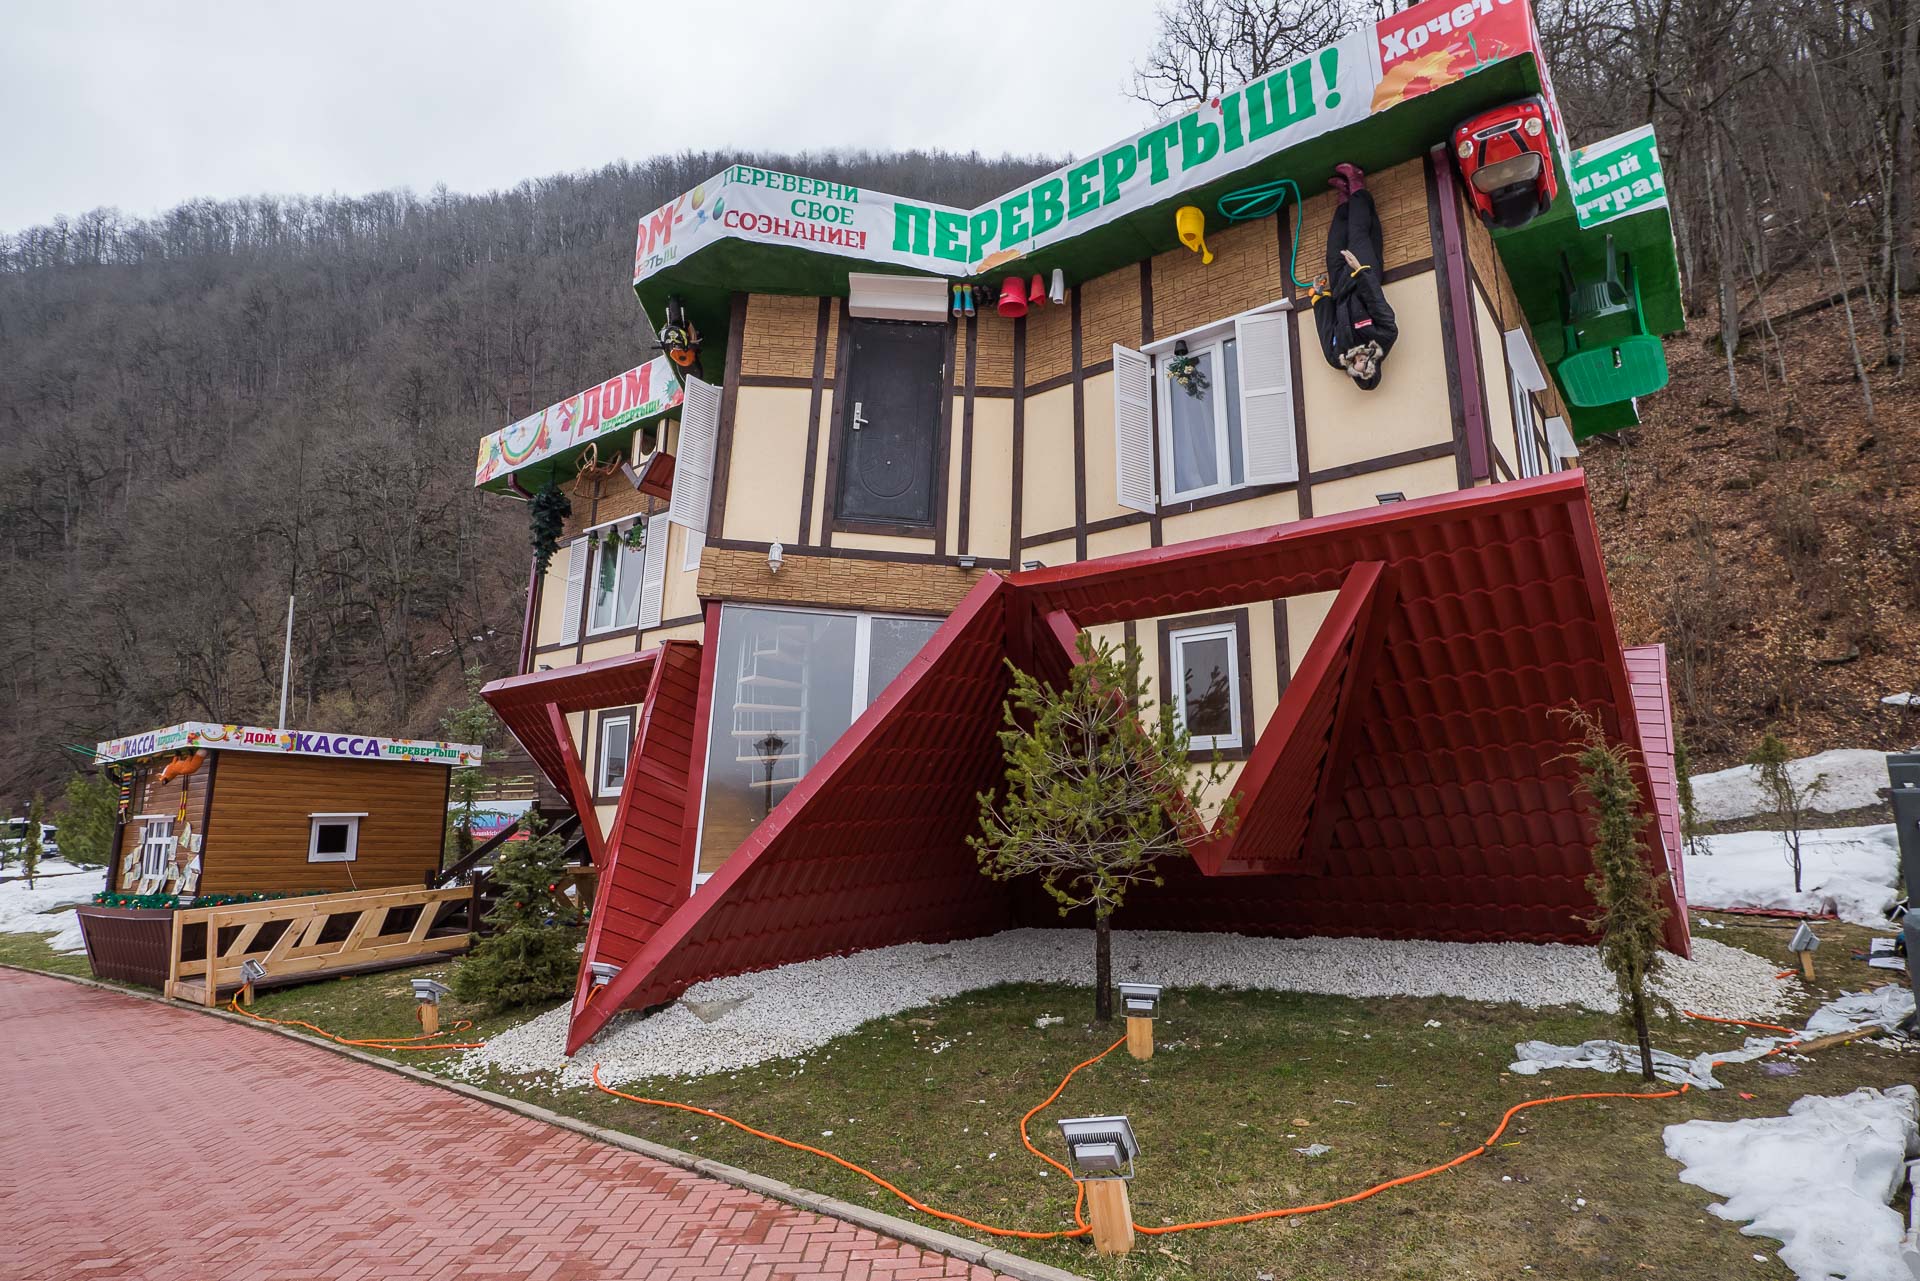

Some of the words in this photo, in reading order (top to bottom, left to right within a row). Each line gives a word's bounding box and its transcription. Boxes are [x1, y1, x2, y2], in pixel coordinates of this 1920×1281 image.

[892, 47, 1342, 263] ПЕРЕВЕРТЫШ!
[723, 165, 859, 203] ПЕРЕВЕРНИ
[724, 210, 867, 250] СОЗНАНИЕ!
[791, 199, 854, 225] СВОЕ
[578, 362, 653, 437] ДОМ
[124, 735, 155, 757] КАССА
[243, 732, 278, 744] ДОМ
[296, 733, 381, 757] КАССА
[388, 744, 460, 759] ПЕРЕВЕРТЫШ!
